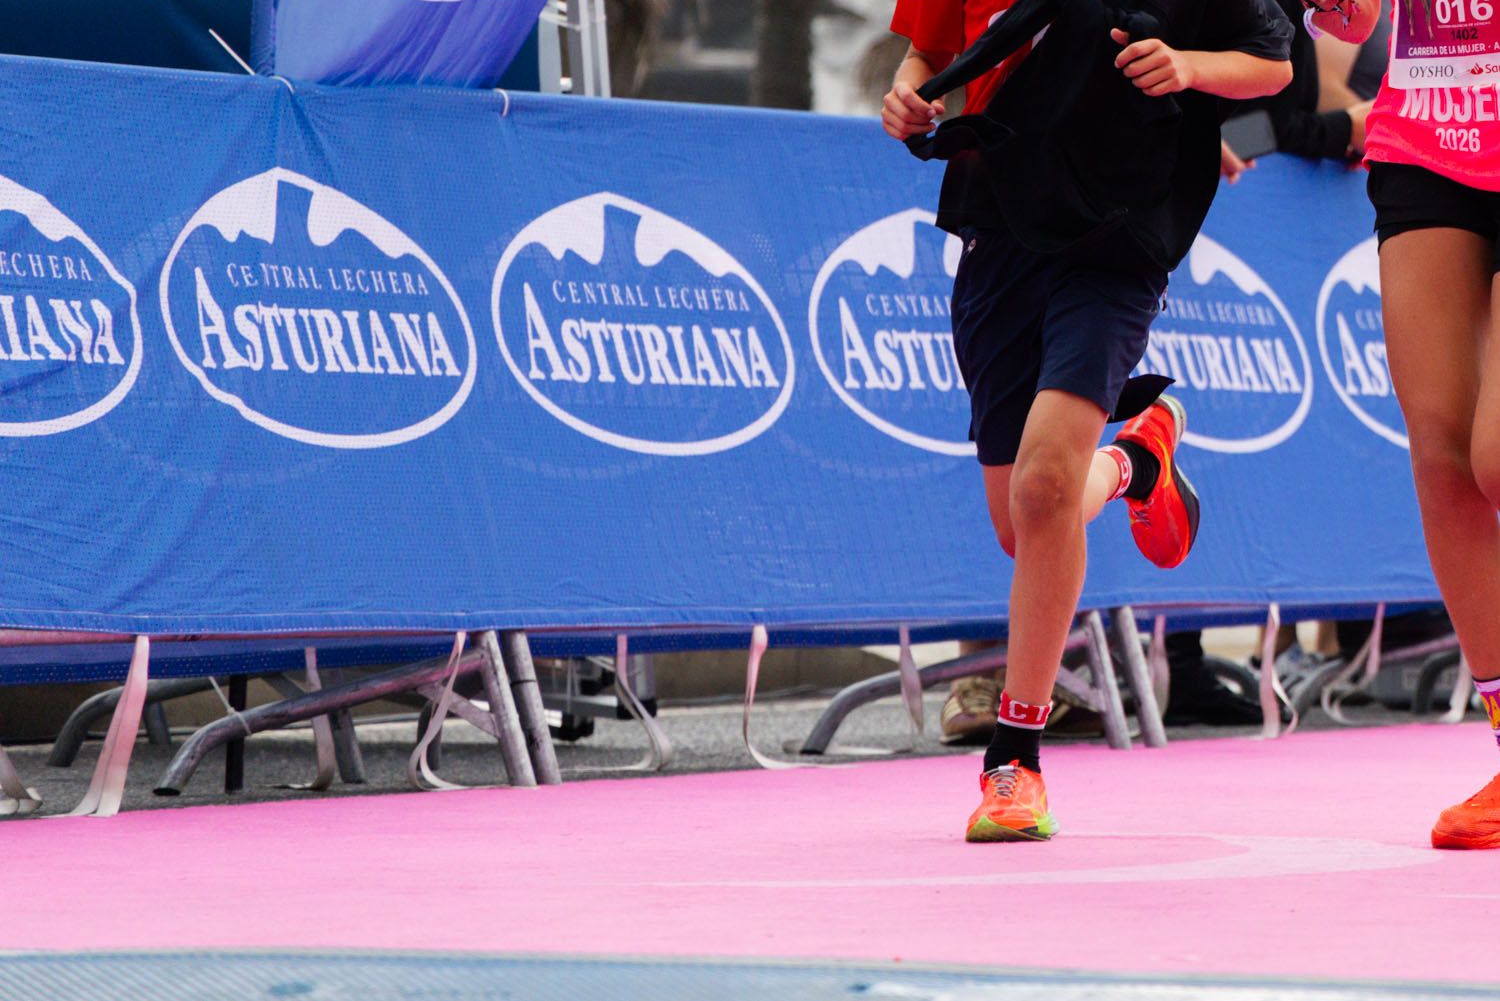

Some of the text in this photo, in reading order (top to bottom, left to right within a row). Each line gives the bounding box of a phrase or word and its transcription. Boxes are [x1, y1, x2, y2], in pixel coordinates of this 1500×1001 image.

[1451, 28, 1478, 40] 1402
[1408, 45, 1438, 56] CARRERA
[1440, 46, 1448, 55] DE
[1449, 45, 1456, 54] LA
[1457, 43, 1486, 54] MUJER
[1493, 42, 1500, 50] A
[1409, 64, 1454, 79] OYSHO
[1435, 127, 1481, 154] 2026
[0, 250, 93, 282] ECHERA
[226, 262, 430, 296] CENTRAL LECHERA
[552, 279, 751, 313] CENTRAL LECHERA
[1159, 297, 1206, 322] TRAL
[194, 266, 462, 377] ASTURIANA
[523, 281, 780, 388] ASTURIANA
